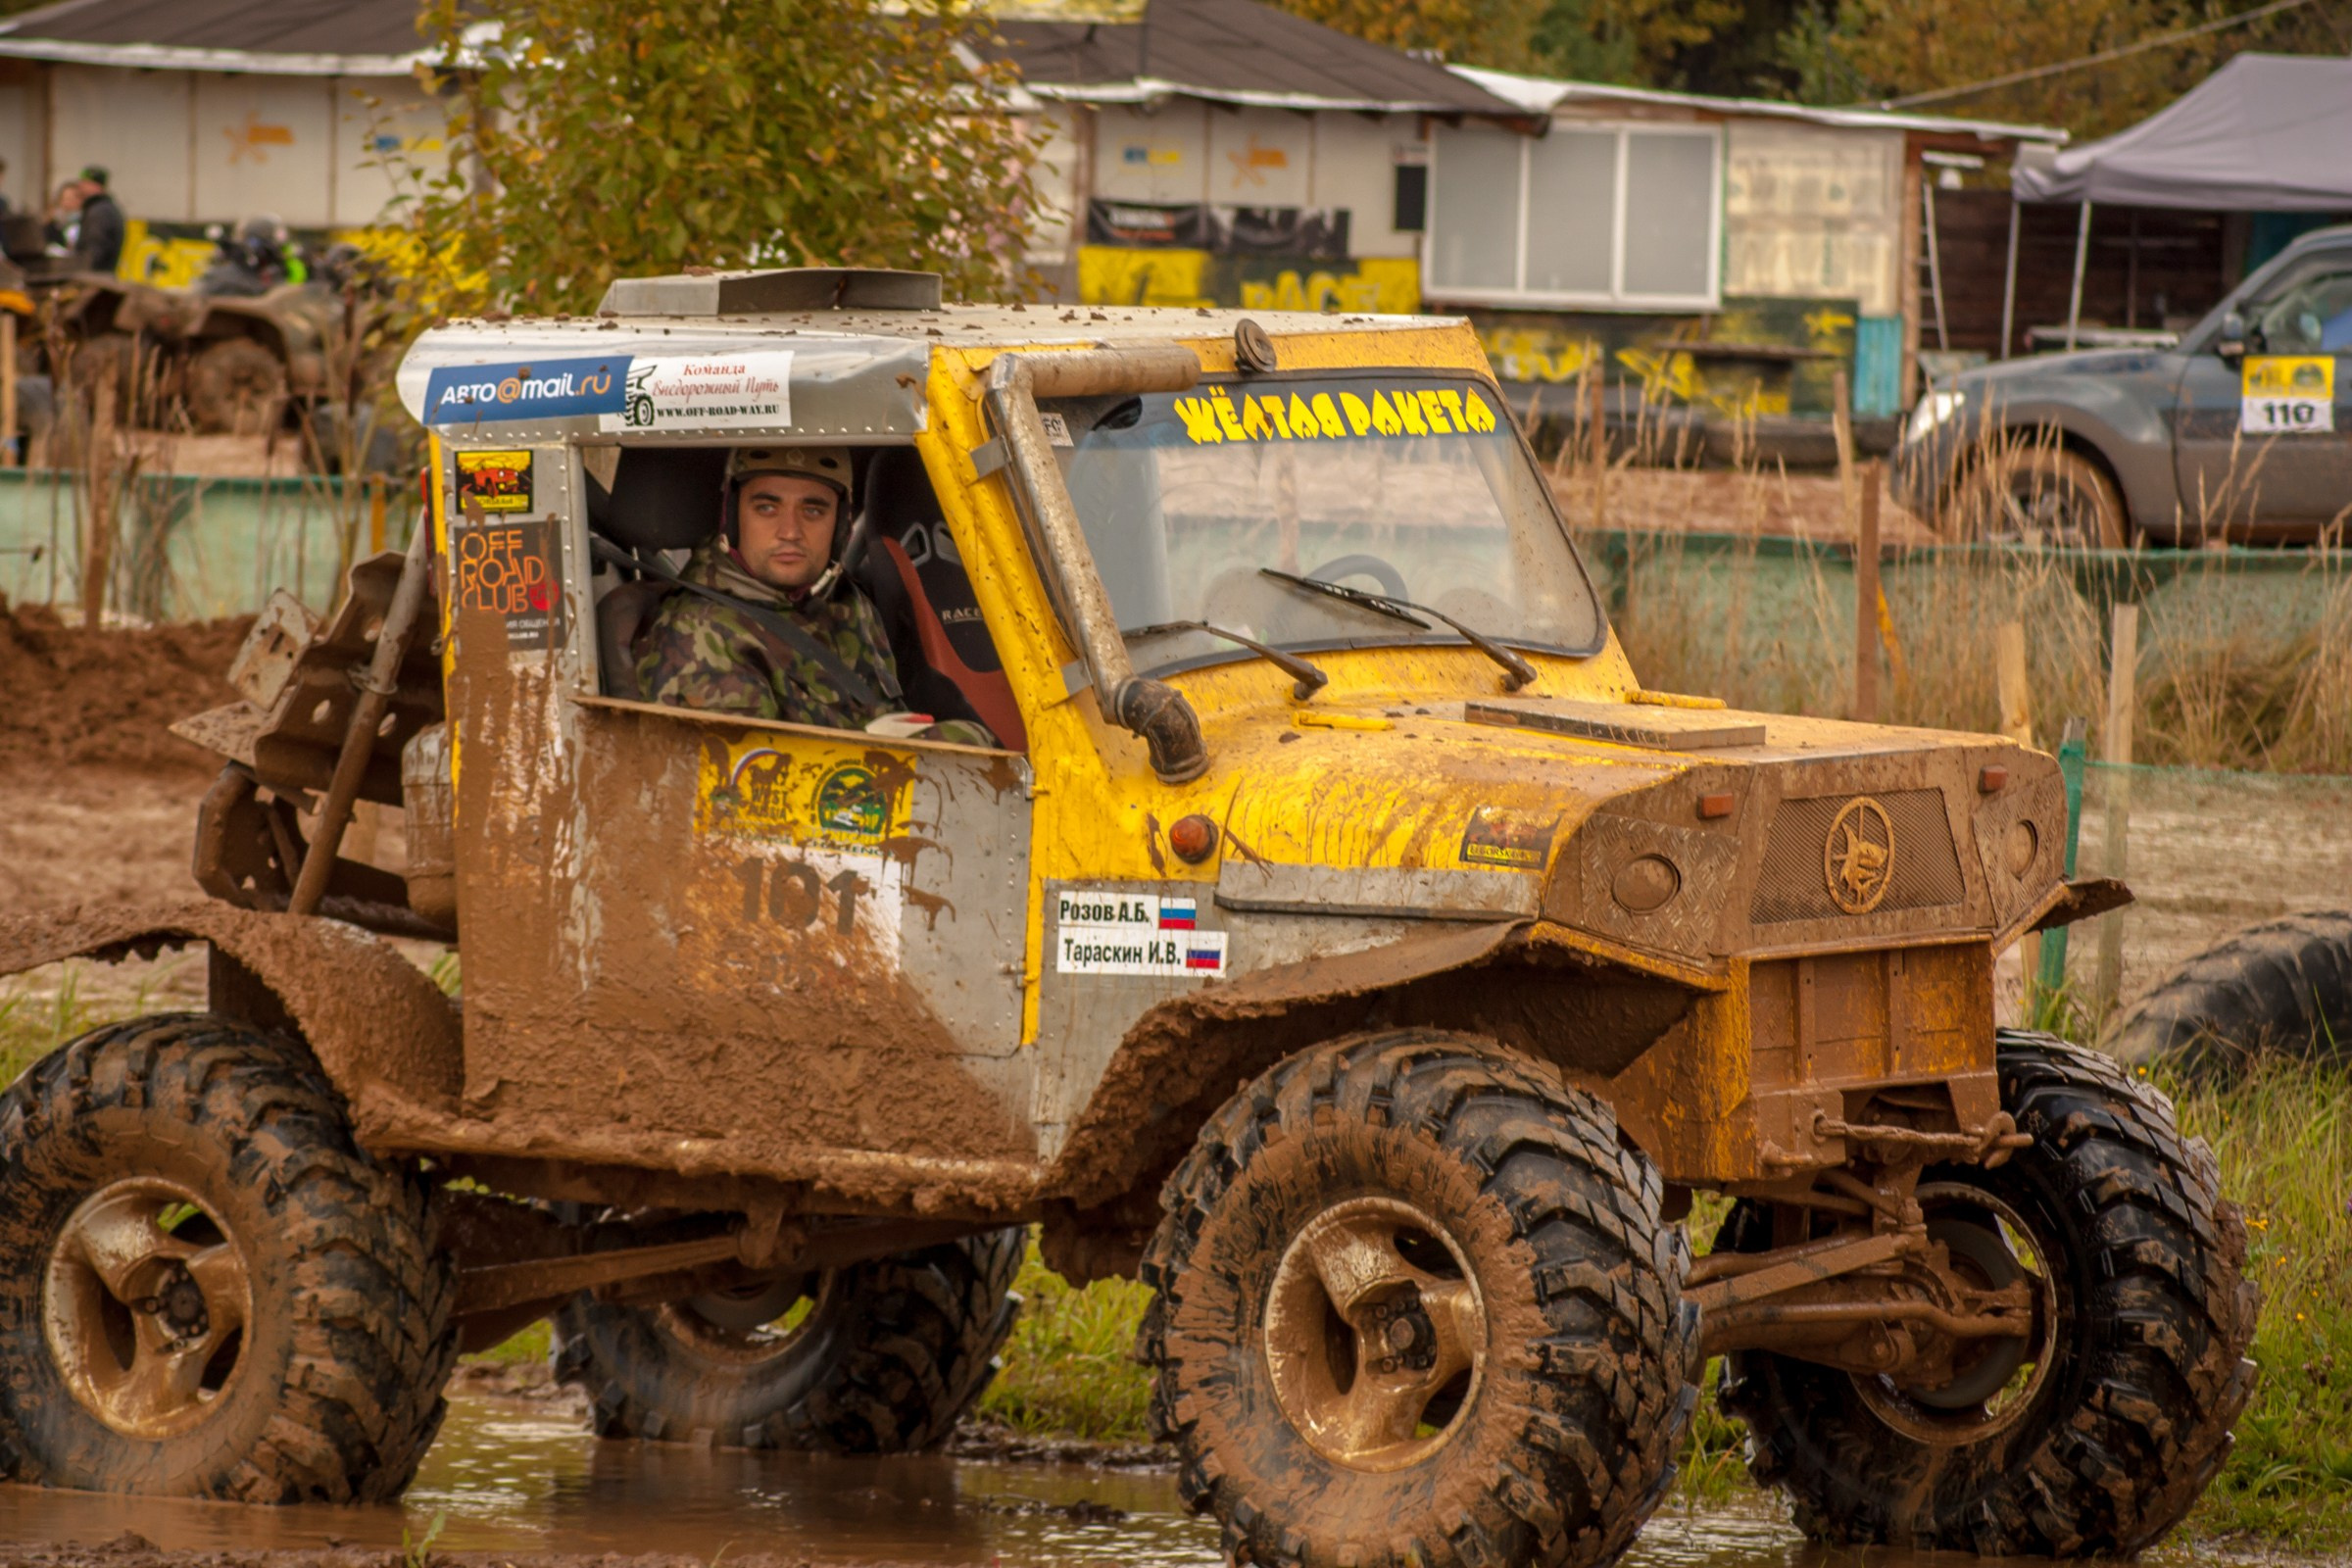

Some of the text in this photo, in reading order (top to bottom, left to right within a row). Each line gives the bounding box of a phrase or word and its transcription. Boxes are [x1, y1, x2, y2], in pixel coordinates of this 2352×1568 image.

[683, 364, 746, 375] Команда
[745, 376, 780, 402] Путь
[657, 405, 780, 417] WWW.OFF-ROAD-WAY.RU
[1173, 385, 1496, 445] ЖЁЛТАЯ РАКЕТА
[2263, 403, 2315, 424] 110
[461, 530, 522, 563] OFF
[460, 556, 545, 589] ROAD
[462, 583, 528, 613] CLUB
[735, 858, 858, 935] 101
[1059, 900, 1150, 922] Розов А.Б.
[1064, 938, 1181, 967] Тараскин И.В.
